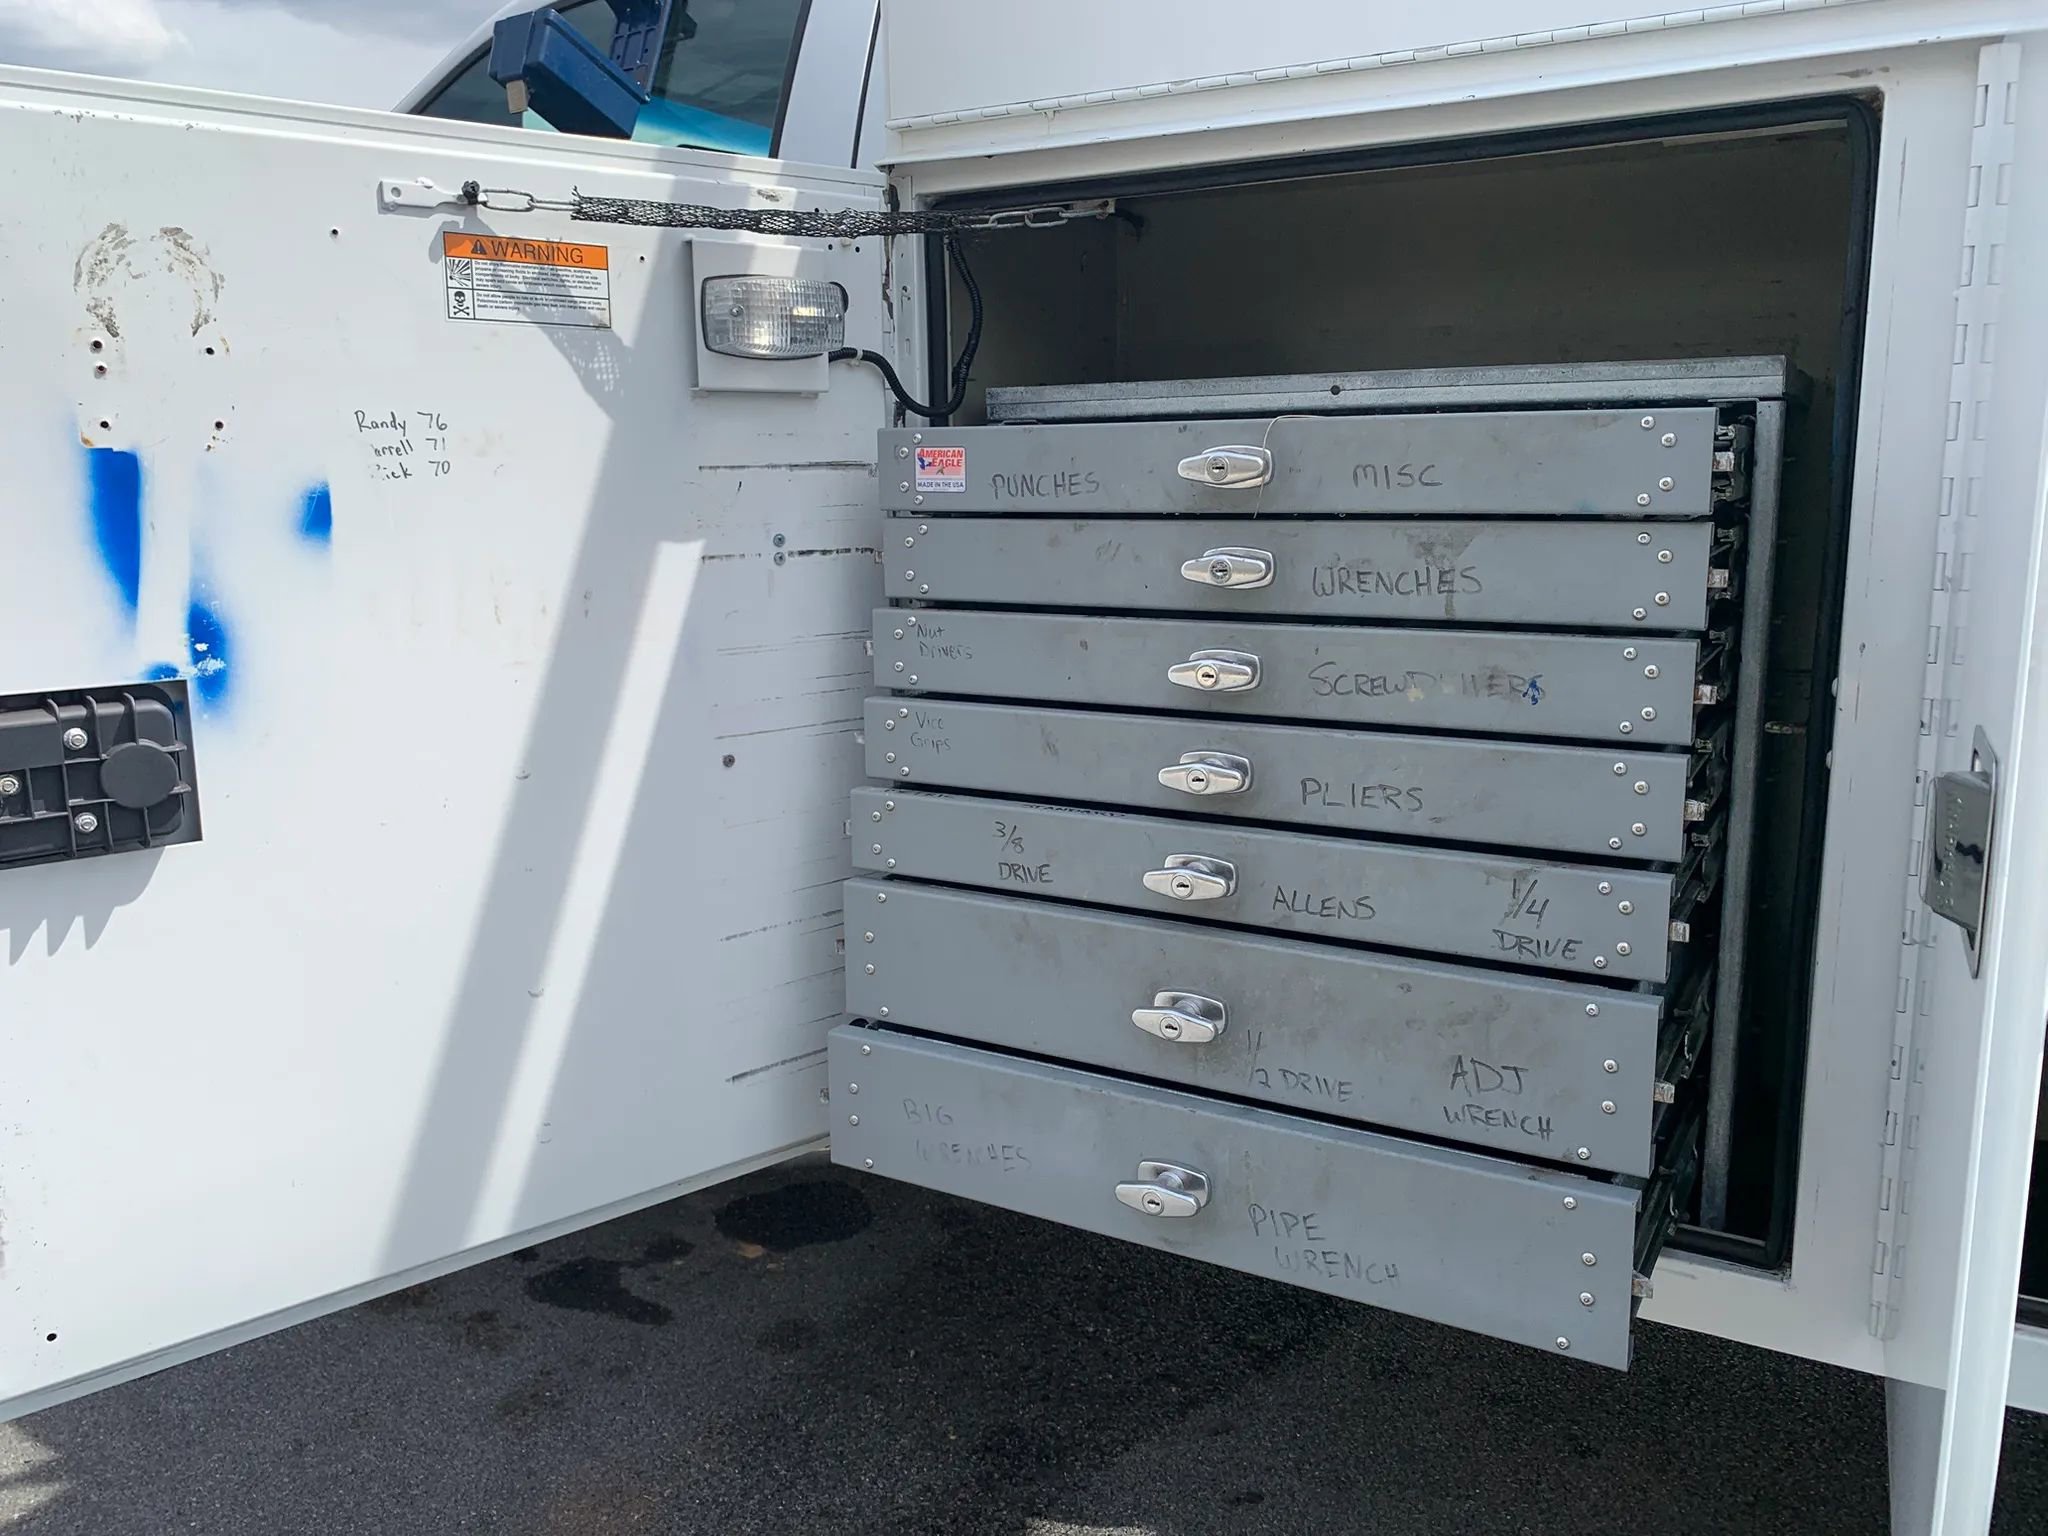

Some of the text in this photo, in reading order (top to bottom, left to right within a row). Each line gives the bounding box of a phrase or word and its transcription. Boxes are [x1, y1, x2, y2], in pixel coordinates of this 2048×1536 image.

[490, 240, 585, 264] WARNING
[354, 410, 448, 437] Randy 76
[370, 437, 446, 457] arrell 71
[917, 448, 964, 458] AMERICAN
[428, 460, 451, 477] 70
[932, 458, 963, 469] EAGLE
[1353, 463, 1443, 490] MISC
[991, 471, 1101, 500] PUNCHES
[1312, 565, 1484, 598] WRENCHES
[917, 623, 946, 639] Nut
[1300, 777, 1424, 812] PLIERS
[998, 862, 1054, 884] DRIVE
[1272, 885, 1377, 921] ALLENS
[1492, 928, 1584, 960] DRIVE
[1278, 1067, 1353, 1103] DRIVE
[1450, 1054, 1529, 1098] ADJ
[902, 1098, 954, 1126] BIG
[1442, 1104, 1555, 1142] WRENCH
[1248, 1203, 1327, 1241] PIPE
[1274, 1246, 1400, 1287] WRENCH
